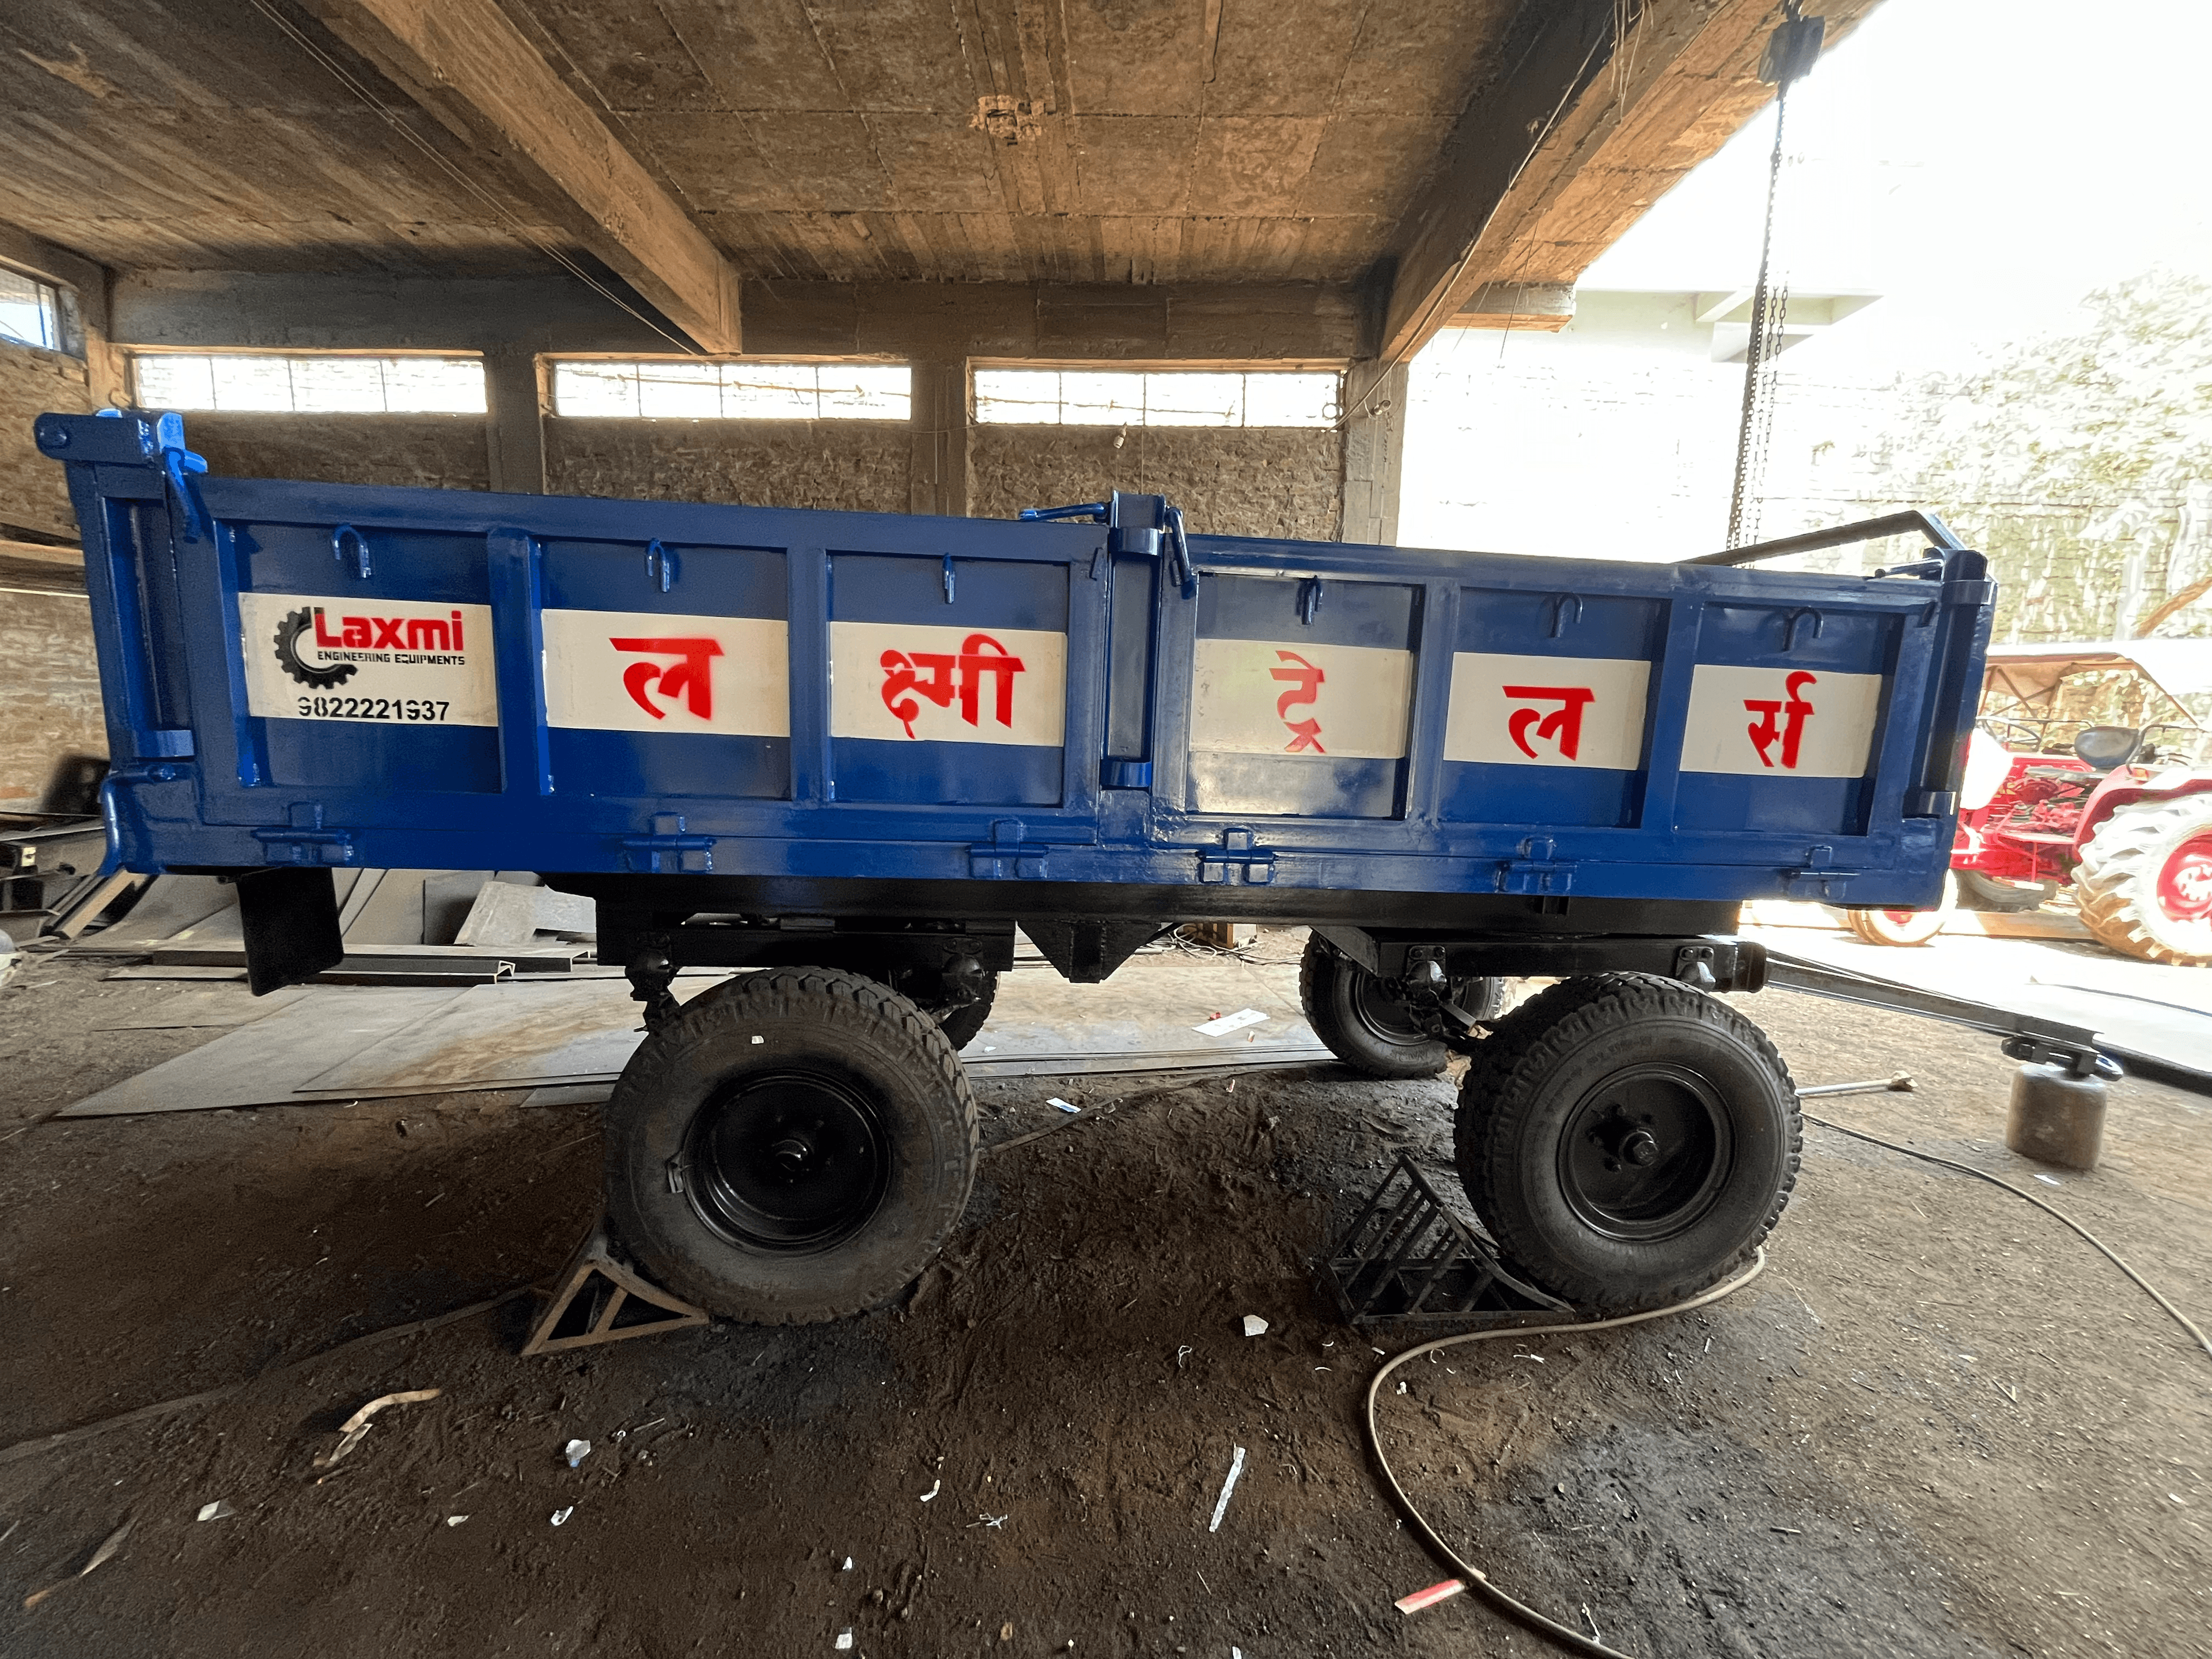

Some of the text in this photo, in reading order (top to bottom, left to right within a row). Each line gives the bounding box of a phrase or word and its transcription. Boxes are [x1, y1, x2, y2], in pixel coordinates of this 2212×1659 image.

[314, 607, 464, 651] Laxmi
[317, 651, 465, 665] ENGINEERING EQUIPMENTS
[297, 696, 450, 721] 9822221937
